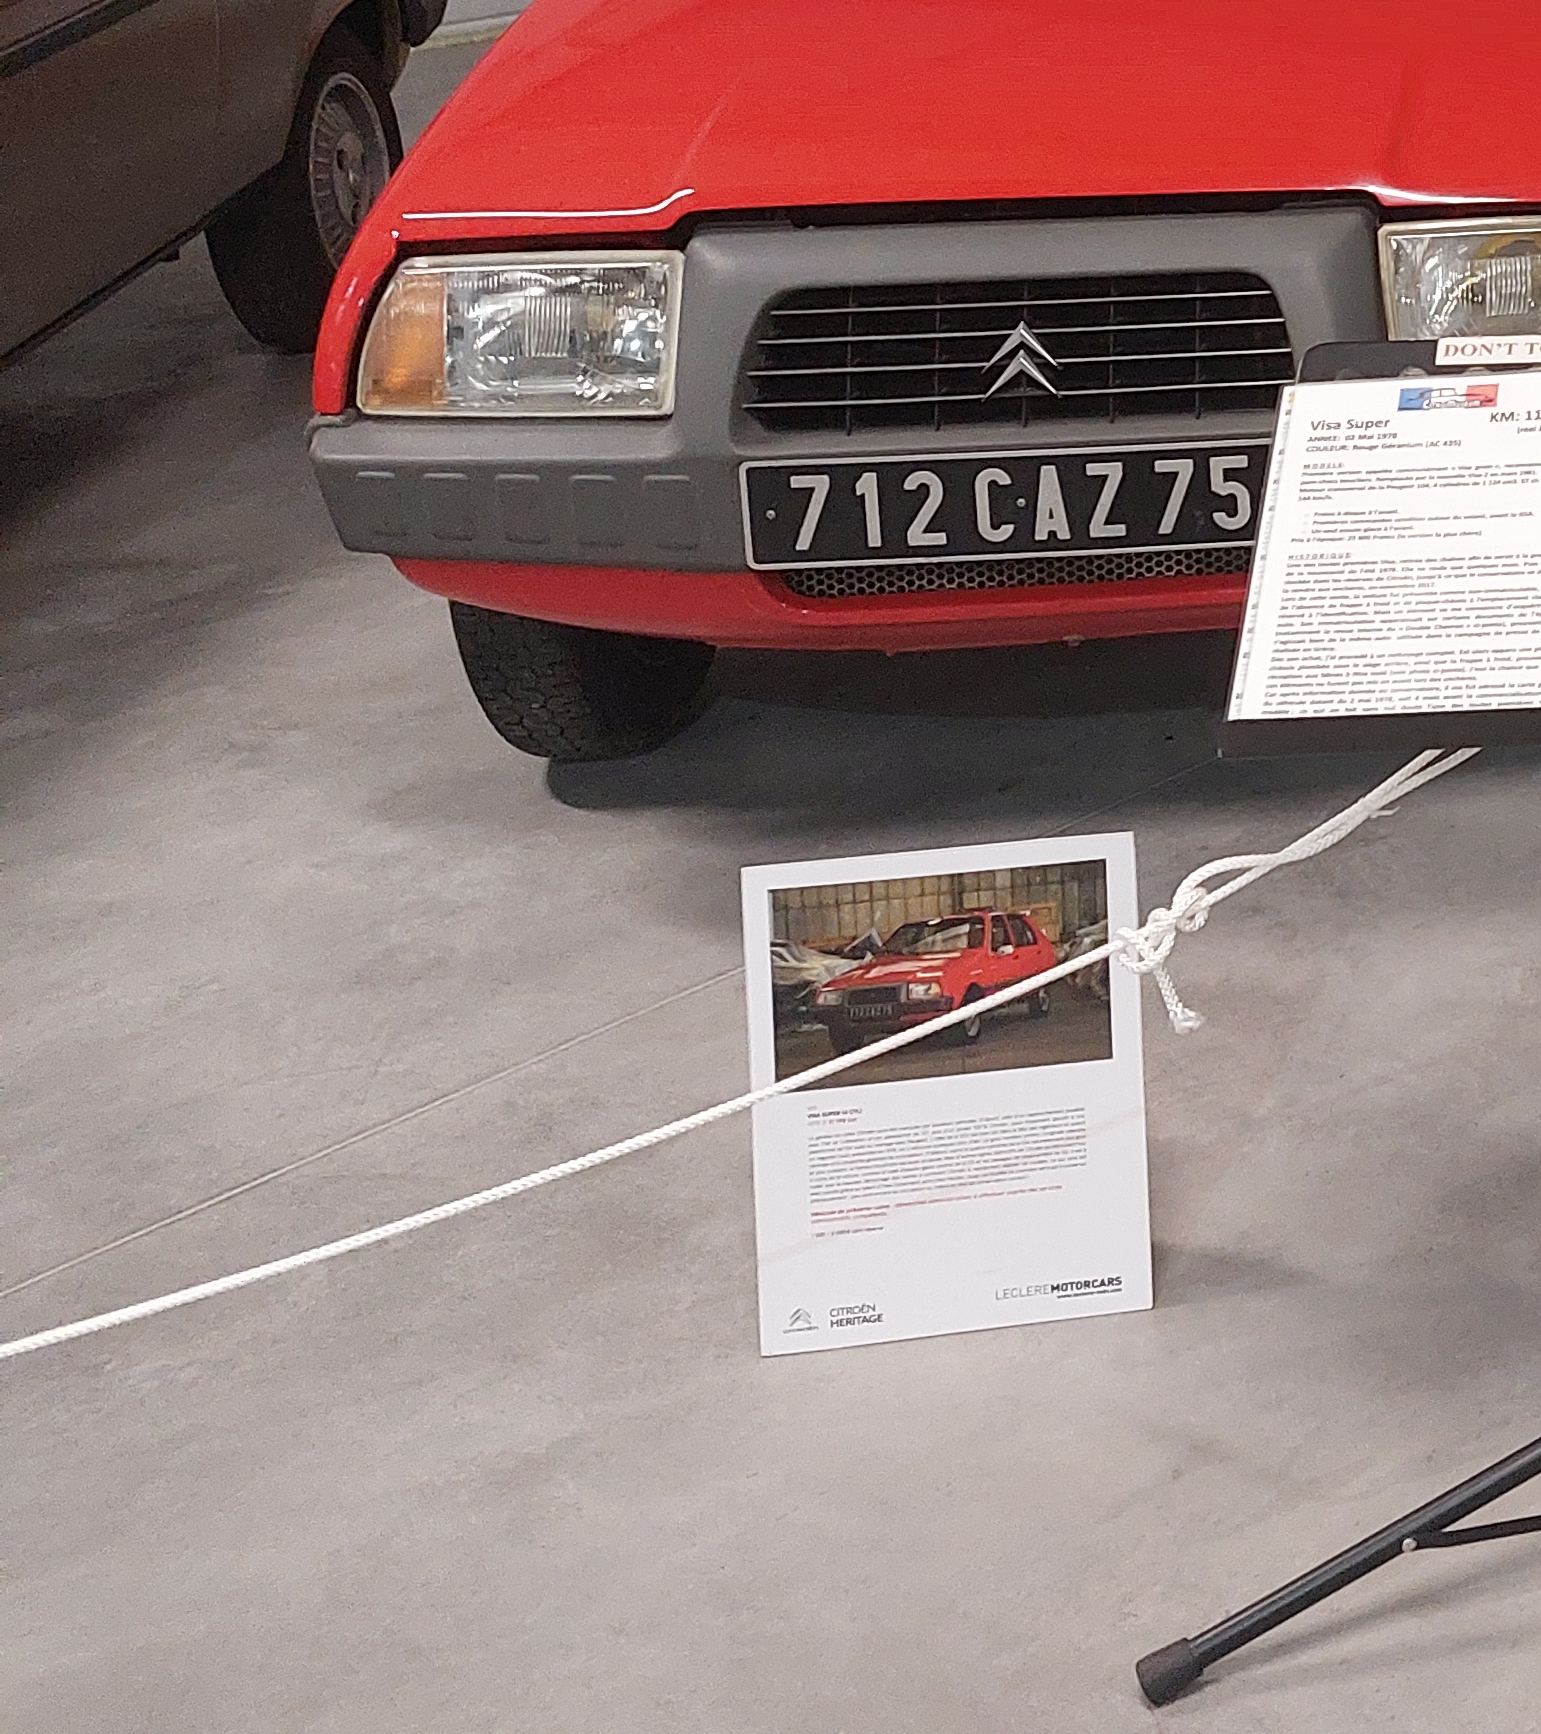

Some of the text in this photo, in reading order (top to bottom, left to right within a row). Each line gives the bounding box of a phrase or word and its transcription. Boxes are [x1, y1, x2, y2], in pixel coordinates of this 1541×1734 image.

[1443, 343, 1519, 358] DON'T
[1490, 412, 1520, 423] KM:
[1525, 409, 1541, 421] 11
[1311, 418, 1391, 432] Visa Super
[789, 471, 948, 552] 712
[974, 462, 1128, 543] CAZ
[1154, 455, 1252, 535] 75
[830, 1313, 884, 1329] HERITAGE
